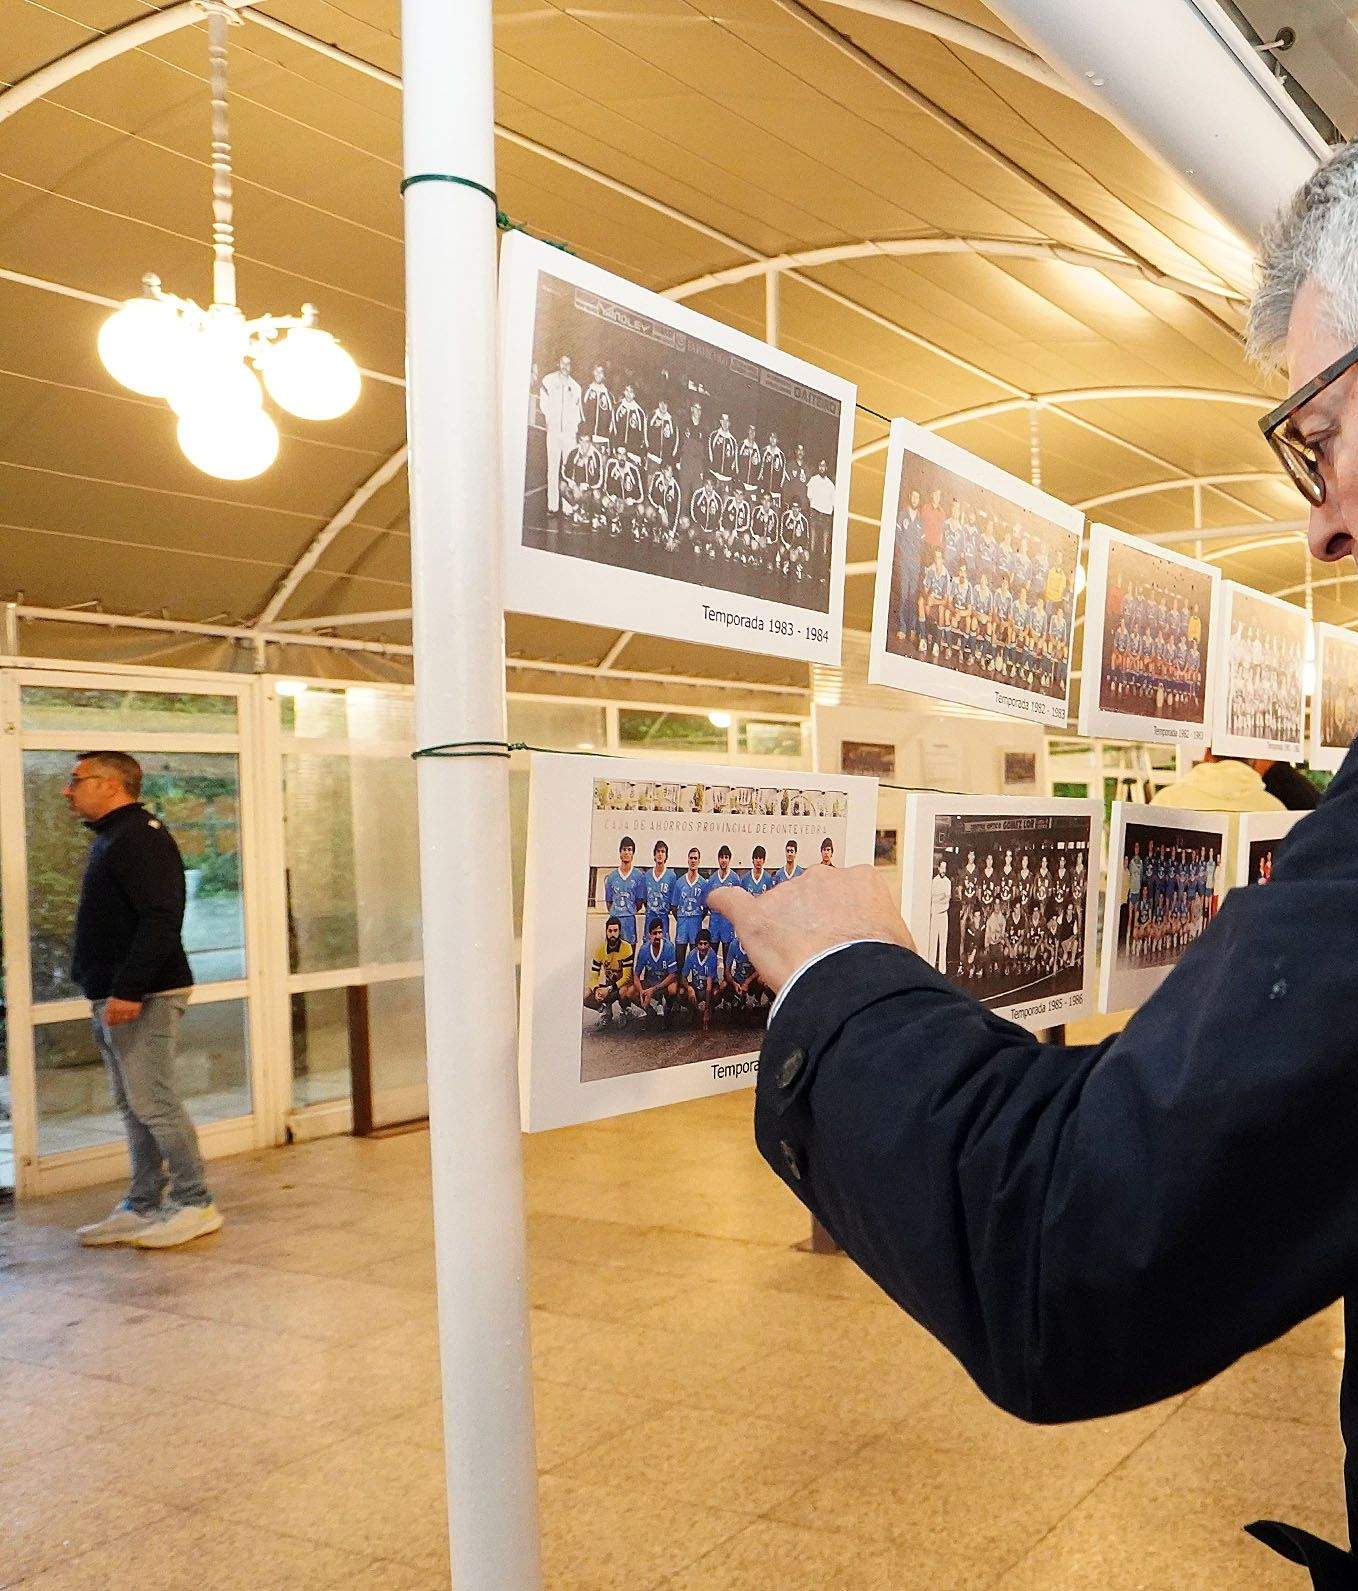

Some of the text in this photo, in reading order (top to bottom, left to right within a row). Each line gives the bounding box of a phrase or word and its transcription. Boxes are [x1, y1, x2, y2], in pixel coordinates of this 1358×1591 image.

[702, 604, 764, 632] Temporada
[768, 618, 794, 637] 1983
[805, 626, 829, 642] 1984
[994, 691, 1029, 711] Temporada
[633, 819, 646, 831] DE
[650, 820, 694, 833] AHORROS
[696, 821, 752, 834] PROVINCIAL
[755, 823, 768, 834] DE
[770, 823, 828, 835] PONTEVEDRA
[1011, 1003, 1046, 1020] Temporada
[711, 1060, 760, 1080] Tempora
